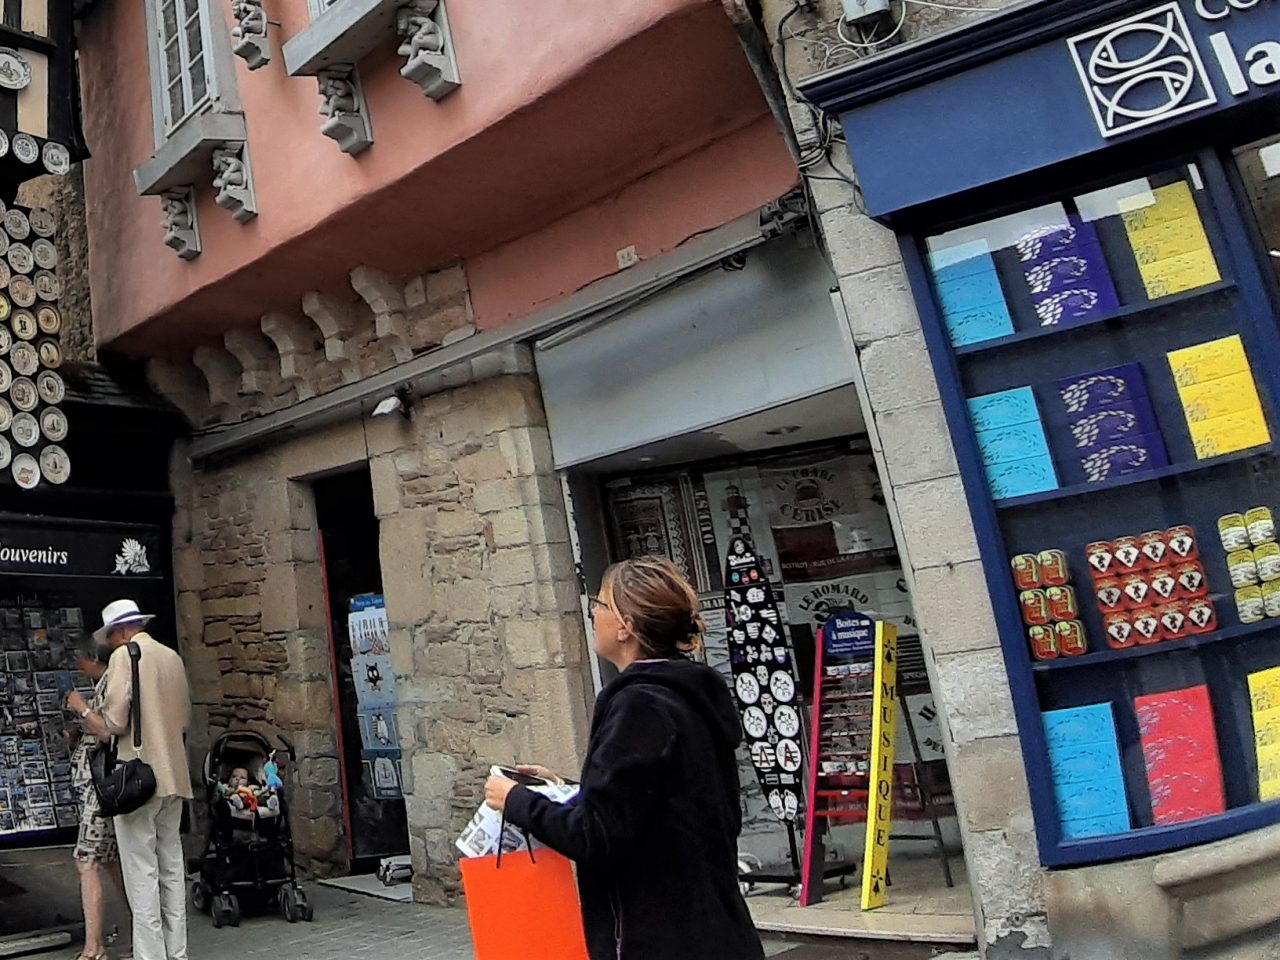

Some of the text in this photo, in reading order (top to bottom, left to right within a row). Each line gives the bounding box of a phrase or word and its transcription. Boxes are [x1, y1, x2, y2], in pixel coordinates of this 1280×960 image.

[810, 583, 869, 605] HOMARD
[837, 627, 869, 640] musique
[877, 681, 895, 847] MUSIQUE
